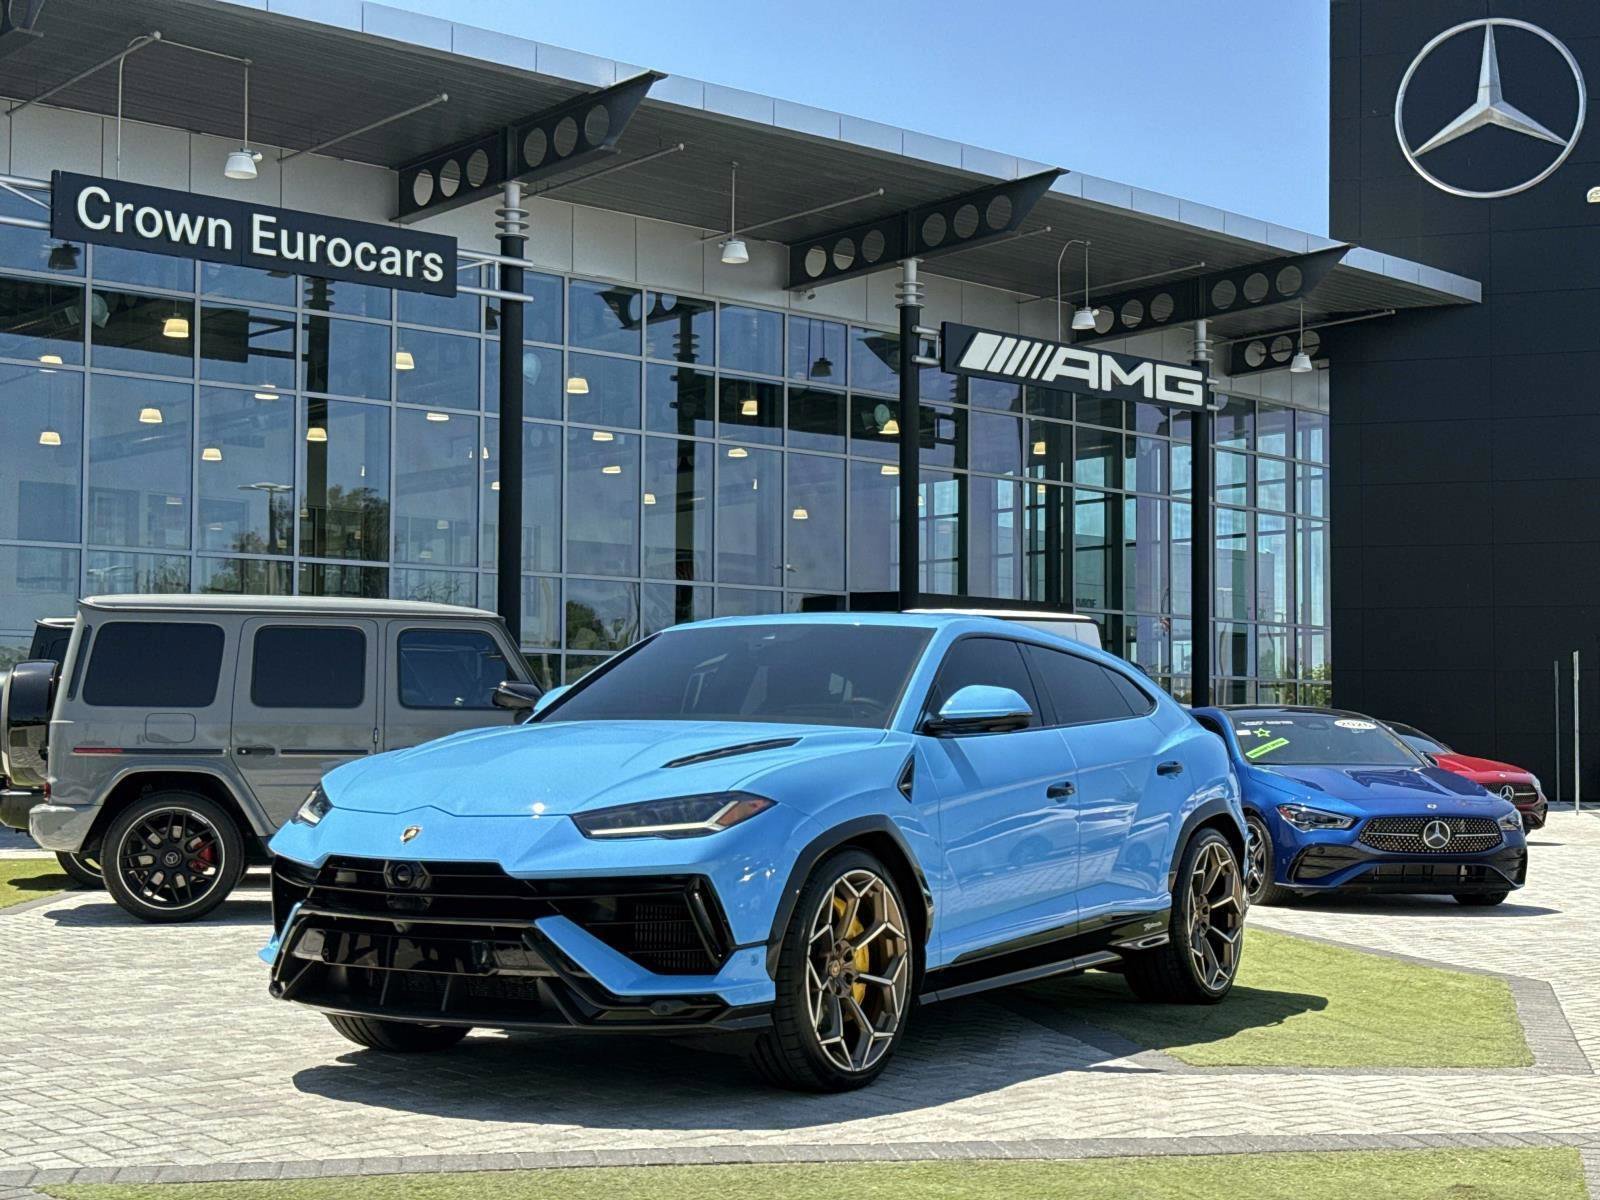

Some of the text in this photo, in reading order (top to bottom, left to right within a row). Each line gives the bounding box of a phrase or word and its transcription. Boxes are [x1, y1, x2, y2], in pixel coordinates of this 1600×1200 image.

[77, 186, 444, 283] Crown Eurocars
[1042, 346, 1203, 406] AMG
